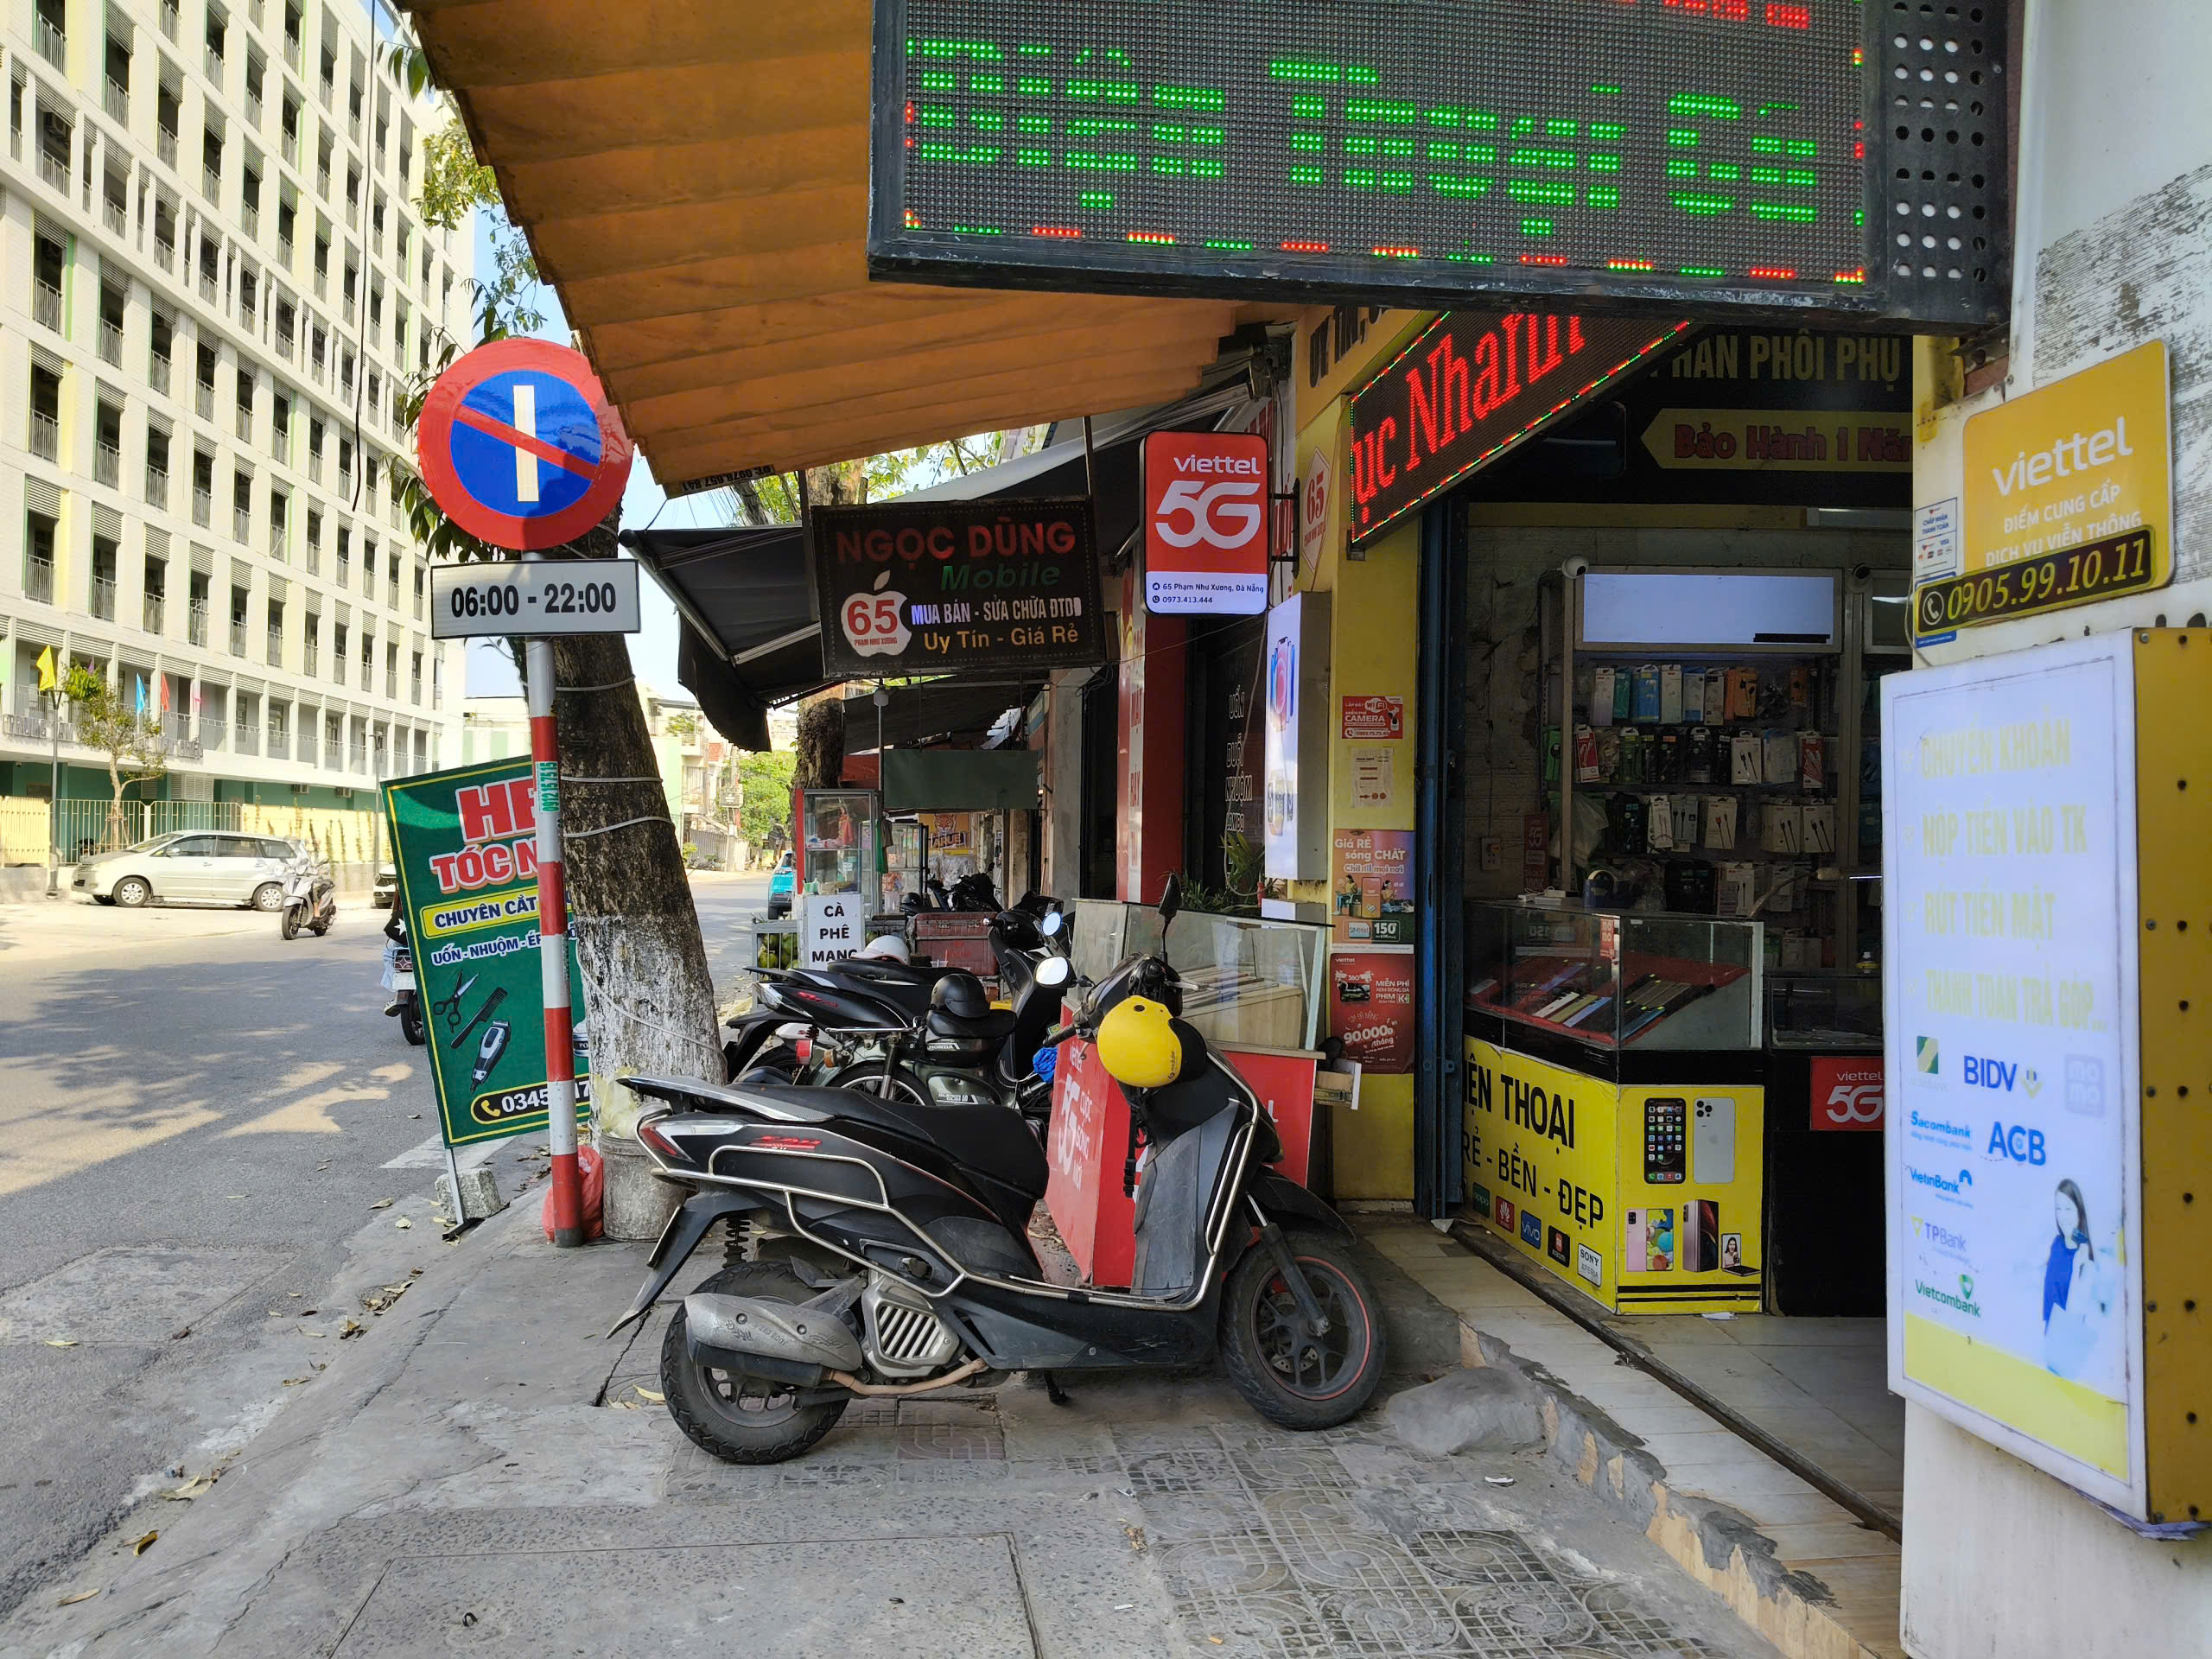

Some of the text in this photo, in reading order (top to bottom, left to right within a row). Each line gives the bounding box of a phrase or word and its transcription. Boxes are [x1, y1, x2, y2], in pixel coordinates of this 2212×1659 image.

[1674, 422, 1737, 460] Bảo
[1745, 424, 1827, 461] Hành
[1992, 416, 2133, 497] viettel
[1173, 454, 1261, 474] viettel
[1306, 470, 1325, 524] 65
[2044, 494, 2086, 523] CUNG
[2089, 477, 2121, 510] CẤP
[1154, 480, 1261, 550] 5G
[836, 517, 1077, 571] NGỌC DŨNG
[939, 562, 1061, 591] Mobile
[1246, 583, 1264, 594] Nẵng
[1947, 537, 2145, 620] 0905.99.10.11
[450, 585, 519, 618] 06:00
[543, 582, 616, 613] 22:00
[847, 599, 898, 636] 65
[911, 603, 941, 626] MUA
[943, 599, 971, 624] BÁN
[983, 594, 1009, 621] SỬA
[1013, 595, 1046, 620] CHỮA
[924, 632, 950, 654] Uy
[957, 630, 990, 649] Tín
[1010, 626, 1045, 645] Giá
[1051, 622, 1078, 644] Rẻ
[1334, 836, 1372, 849] Giá RẺ
[2060, 804, 2088, 855] TK
[430, 840, 514, 893] TÓC
[1344, 848, 1406, 862] sóng CHẤT
[434, 894, 537, 929] CHUYÊN CẮT
[823, 901, 845, 918] CÀ
[819, 924, 850, 940] PHÊ
[433, 943, 461, 965] UỐN
[469, 938, 519, 957] NHUỘM
[1376, 977, 1395, 987] MIỄN
[1836, 1071, 1884, 1081] viettel
[1963, 1054, 2018, 1092] BIDV
[1464, 1052, 1575, 1155] IỆN THOẠI
[1825, 1084, 1884, 1123] 5G
[1910, 1110, 1971, 1139] Sacombank
[1987, 1121, 2047, 1166] ACB
[1498, 1141, 1537, 1198] BỀN
[1557, 1178, 1605, 1230] ĐẸP
[1521, 1221, 1541, 1242] vivo
[1925, 1222, 1967, 1252] TPBank
[1580, 1249, 1599, 1267] SONY
[1915, 1279, 1981, 1319] Vietcombank
